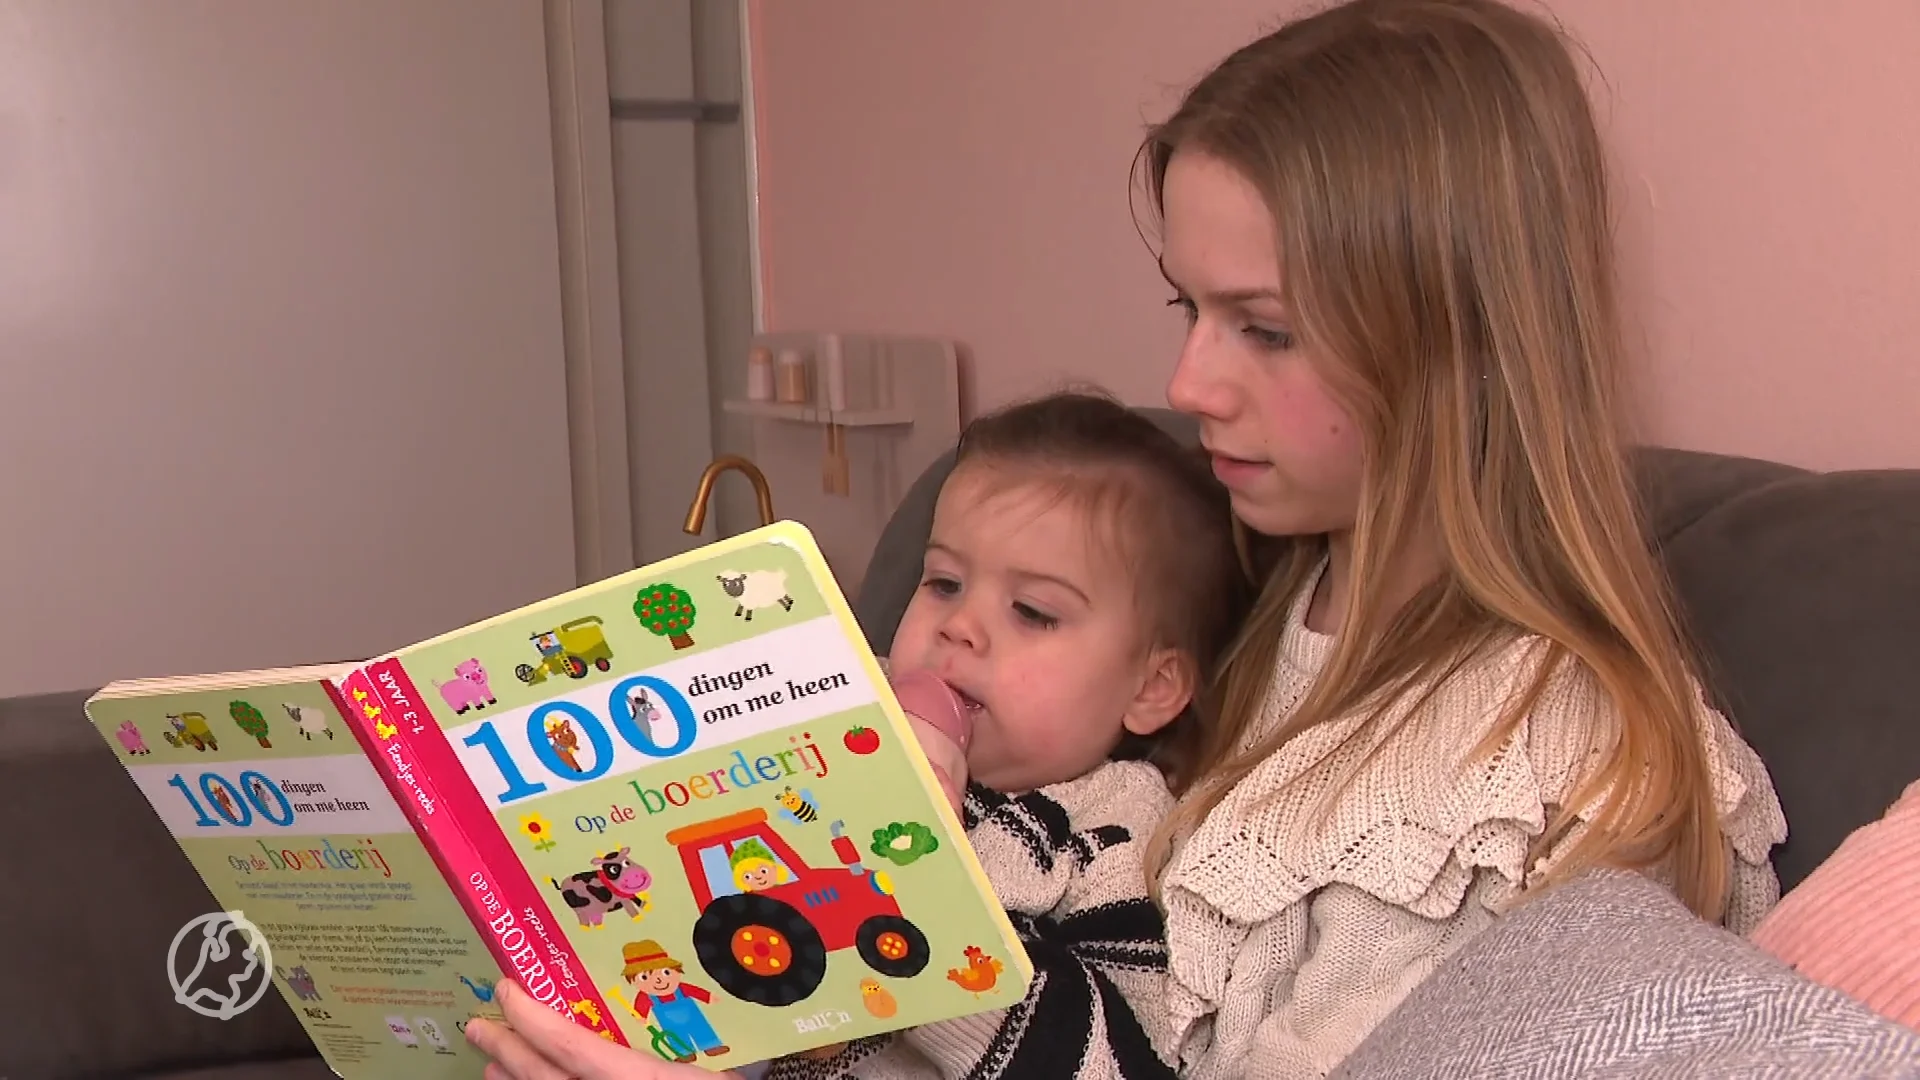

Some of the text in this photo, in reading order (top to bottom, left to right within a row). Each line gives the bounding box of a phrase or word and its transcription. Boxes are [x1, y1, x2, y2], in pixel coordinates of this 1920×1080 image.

[378, 670, 425, 734] 1-3 JAAR
[687, 661, 774, 698] dingen
[702, 671, 850, 725] om me heen
[463, 676, 699, 804] 100
[167, 770, 296, 828] 100
[280, 779, 327, 797] dingen
[293, 798, 371, 814] om me heen
[574, 731, 829, 834] Op de boerderij
[228, 838, 393, 878] Op de boerderij
[469, 871, 489, 892] OP
[481, 891, 502, 915] DE
[523, 907, 579, 989] Eendjes-reeks
